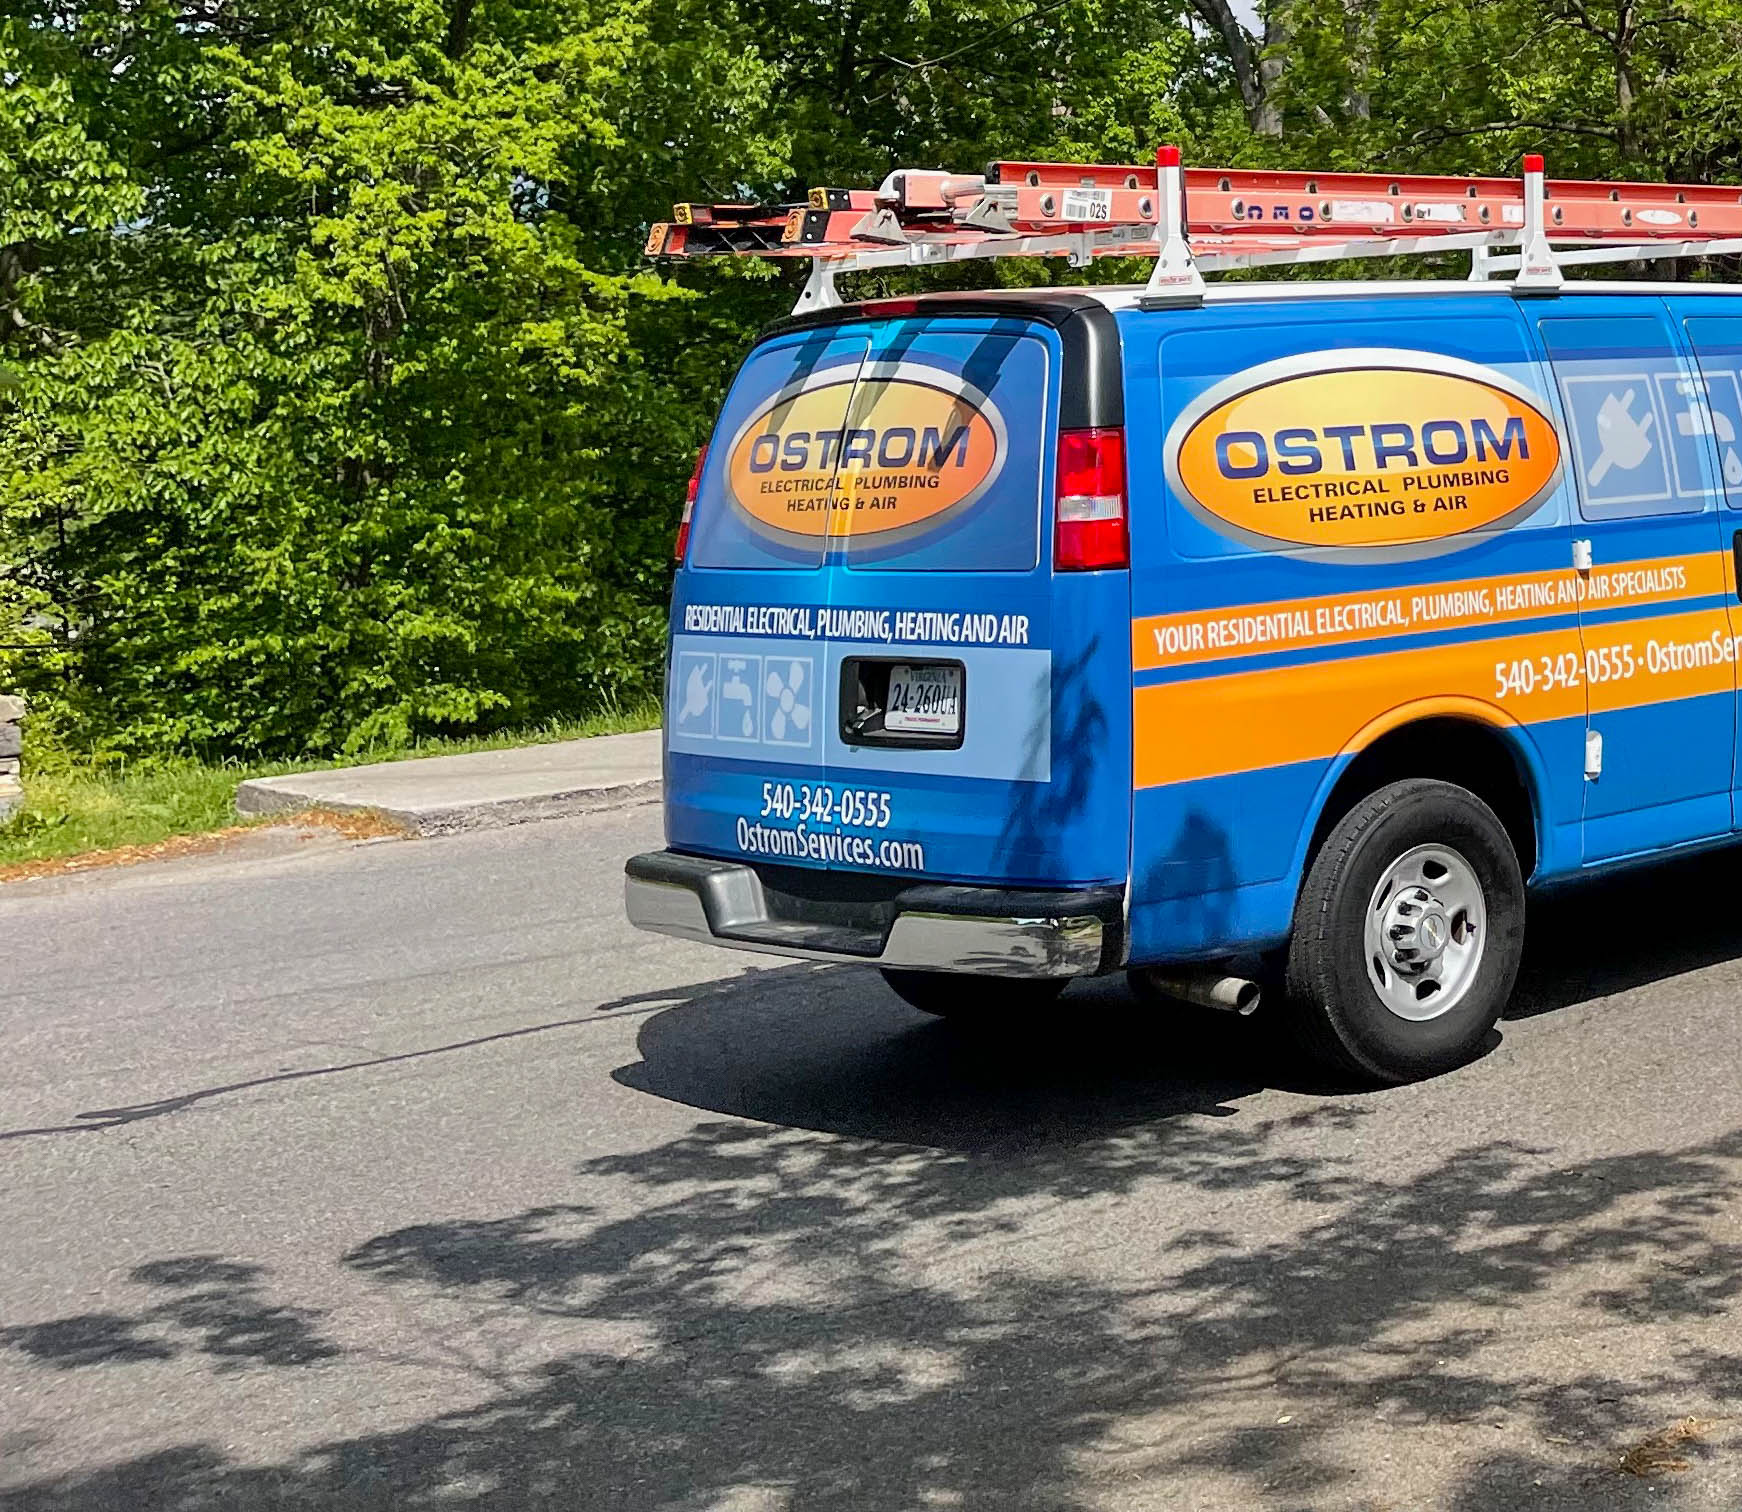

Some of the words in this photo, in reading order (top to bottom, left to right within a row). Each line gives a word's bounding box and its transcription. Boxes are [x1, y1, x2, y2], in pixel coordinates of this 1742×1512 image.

[750, 425, 970, 474] OSTROM
[1215, 417, 1530, 480] OSTROM
[760, 477, 843, 494] ELECTRICAL
[854, 474, 940, 489] PLUMBING
[786, 497, 850, 513] HEATING
[855, 497, 865, 510] &
[869, 496, 897, 510] AIR
[1253, 479, 1390, 504] ELECTRICAL
[1402, 470, 1510, 492] PLUMBING
[1308, 500, 1406, 523] HEATING
[1413, 499, 1427, 514] &
[1433, 495, 1468, 512] AIR
[684, 604, 745, 633] RESIDENTIAL
[747, 606, 815, 640] ELECTRICAL,
[817, 609, 894, 644] PLUMBING,
[894, 611, 962, 642] HEATING
[961, 613, 999, 644] AND
[998, 614, 1029, 645] AIR
[1153, 623, 1206, 655] YOUR
[1207, 610, 1313, 650] RESIDENTIAL
[1316, 599, 1410, 635] ELECTRICAL,
[1411, 589, 1494, 622] PLUMBING,
[1496, 584, 1555, 612] HEATING
[1558, 577, 1586, 605] AND
[1588, 576, 1610, 600] AIR
[1612, 566, 1687, 597] SPECIALISTS
[1495, 644, 1635, 699] 540-342-0555
[760, 782, 892, 828] 540-342-0555
